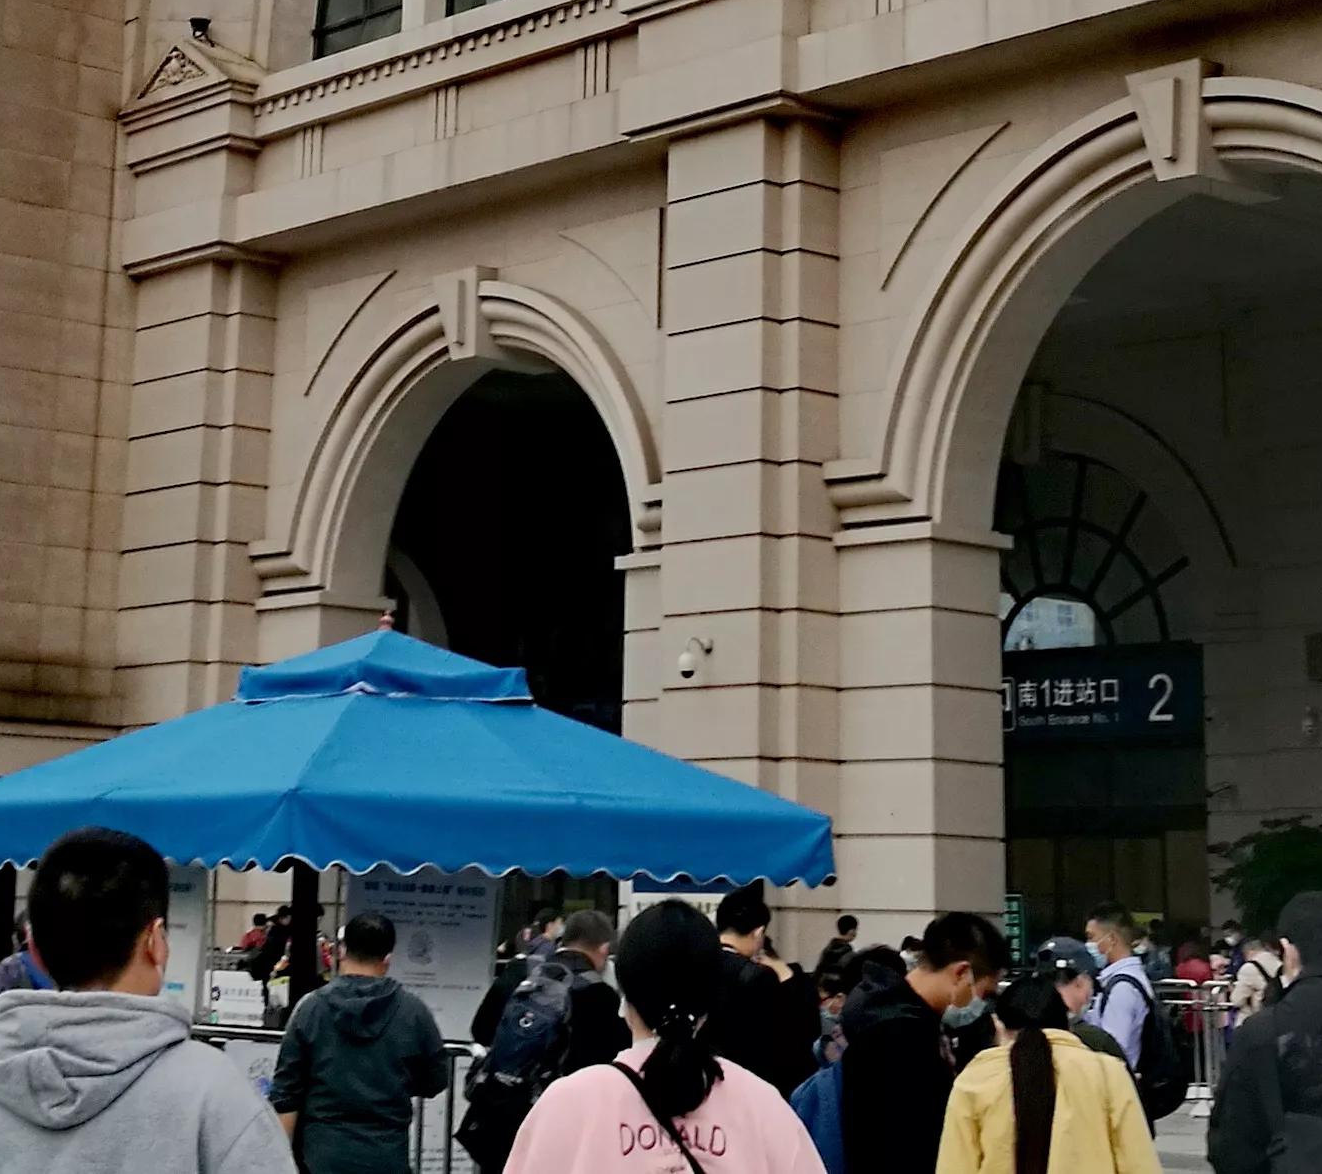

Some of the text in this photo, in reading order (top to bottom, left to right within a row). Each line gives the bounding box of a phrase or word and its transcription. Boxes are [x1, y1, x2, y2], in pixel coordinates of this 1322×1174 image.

[1018, 673, 1174, 721] 南1进站口 2
